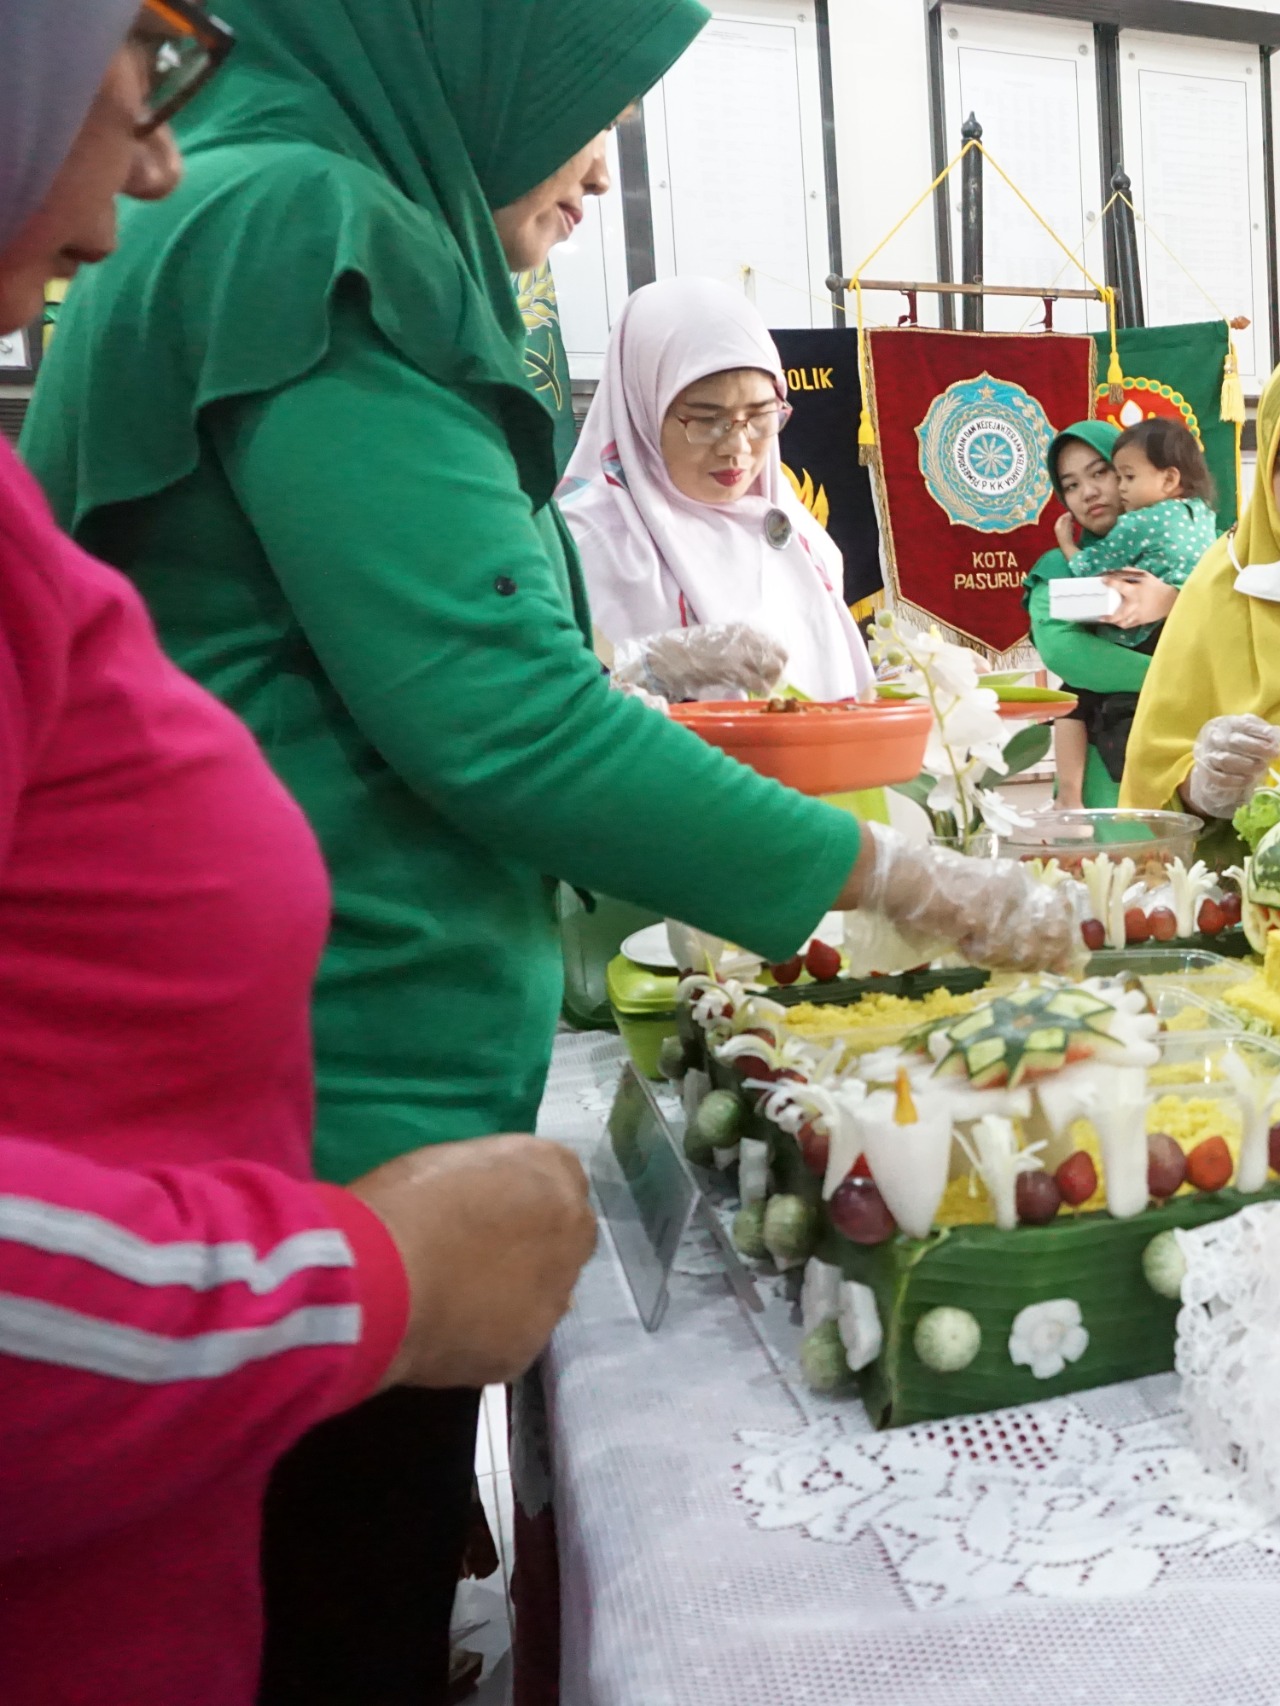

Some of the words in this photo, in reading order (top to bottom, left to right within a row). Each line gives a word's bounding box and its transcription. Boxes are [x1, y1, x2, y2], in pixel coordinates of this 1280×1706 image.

[782, 367, 834, 391] OLIK
[971, 550, 1019, 569] KOTA
[953, 571, 1029, 590] PASURUA
